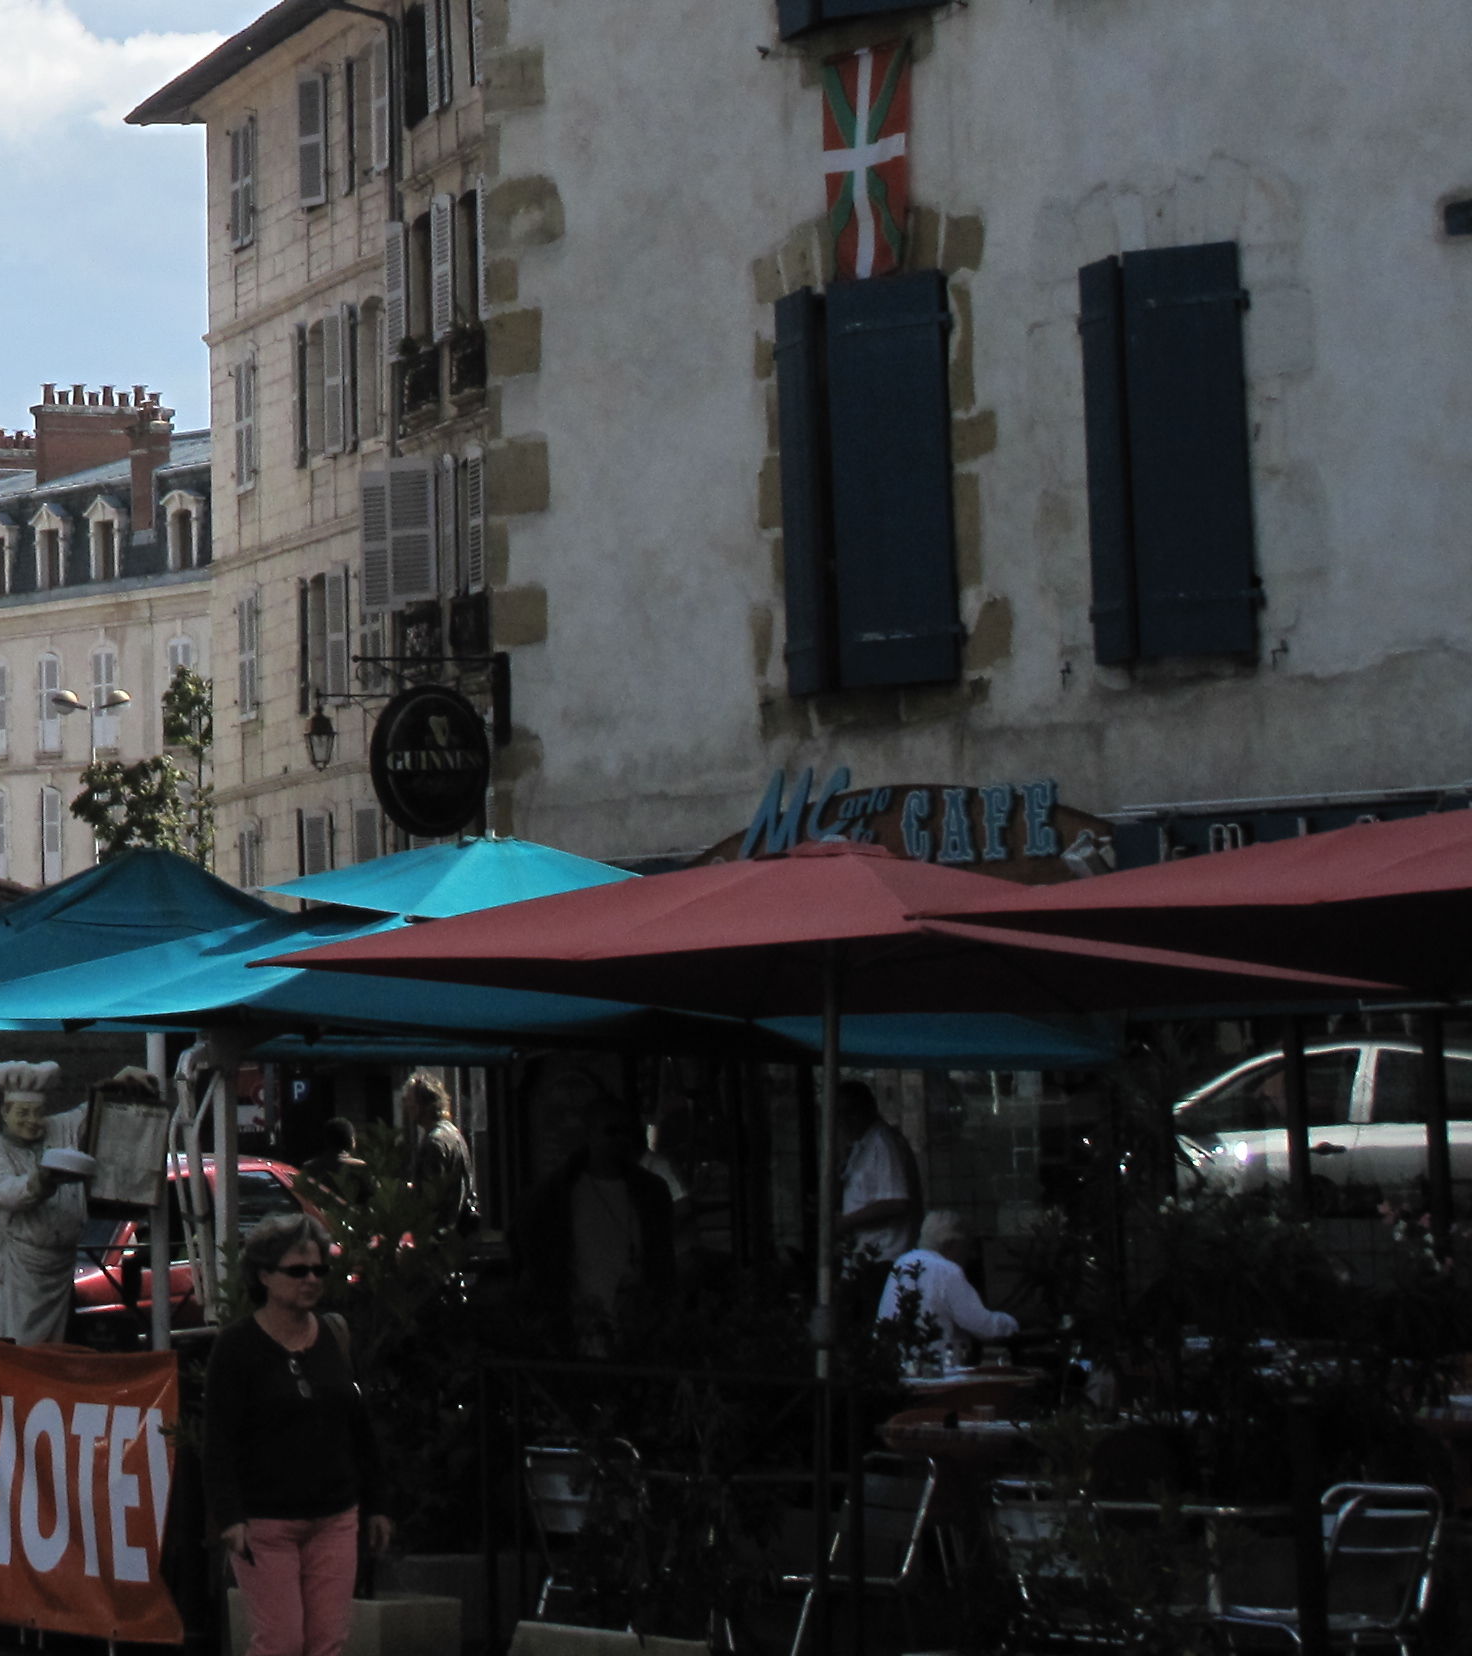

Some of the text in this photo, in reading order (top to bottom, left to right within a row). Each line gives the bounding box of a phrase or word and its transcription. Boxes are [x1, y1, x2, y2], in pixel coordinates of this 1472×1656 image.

[385, 750, 483, 771] GUINNESS
[899, 778, 1061, 863] CAFE
[292, 1080, 306, 1100] P
